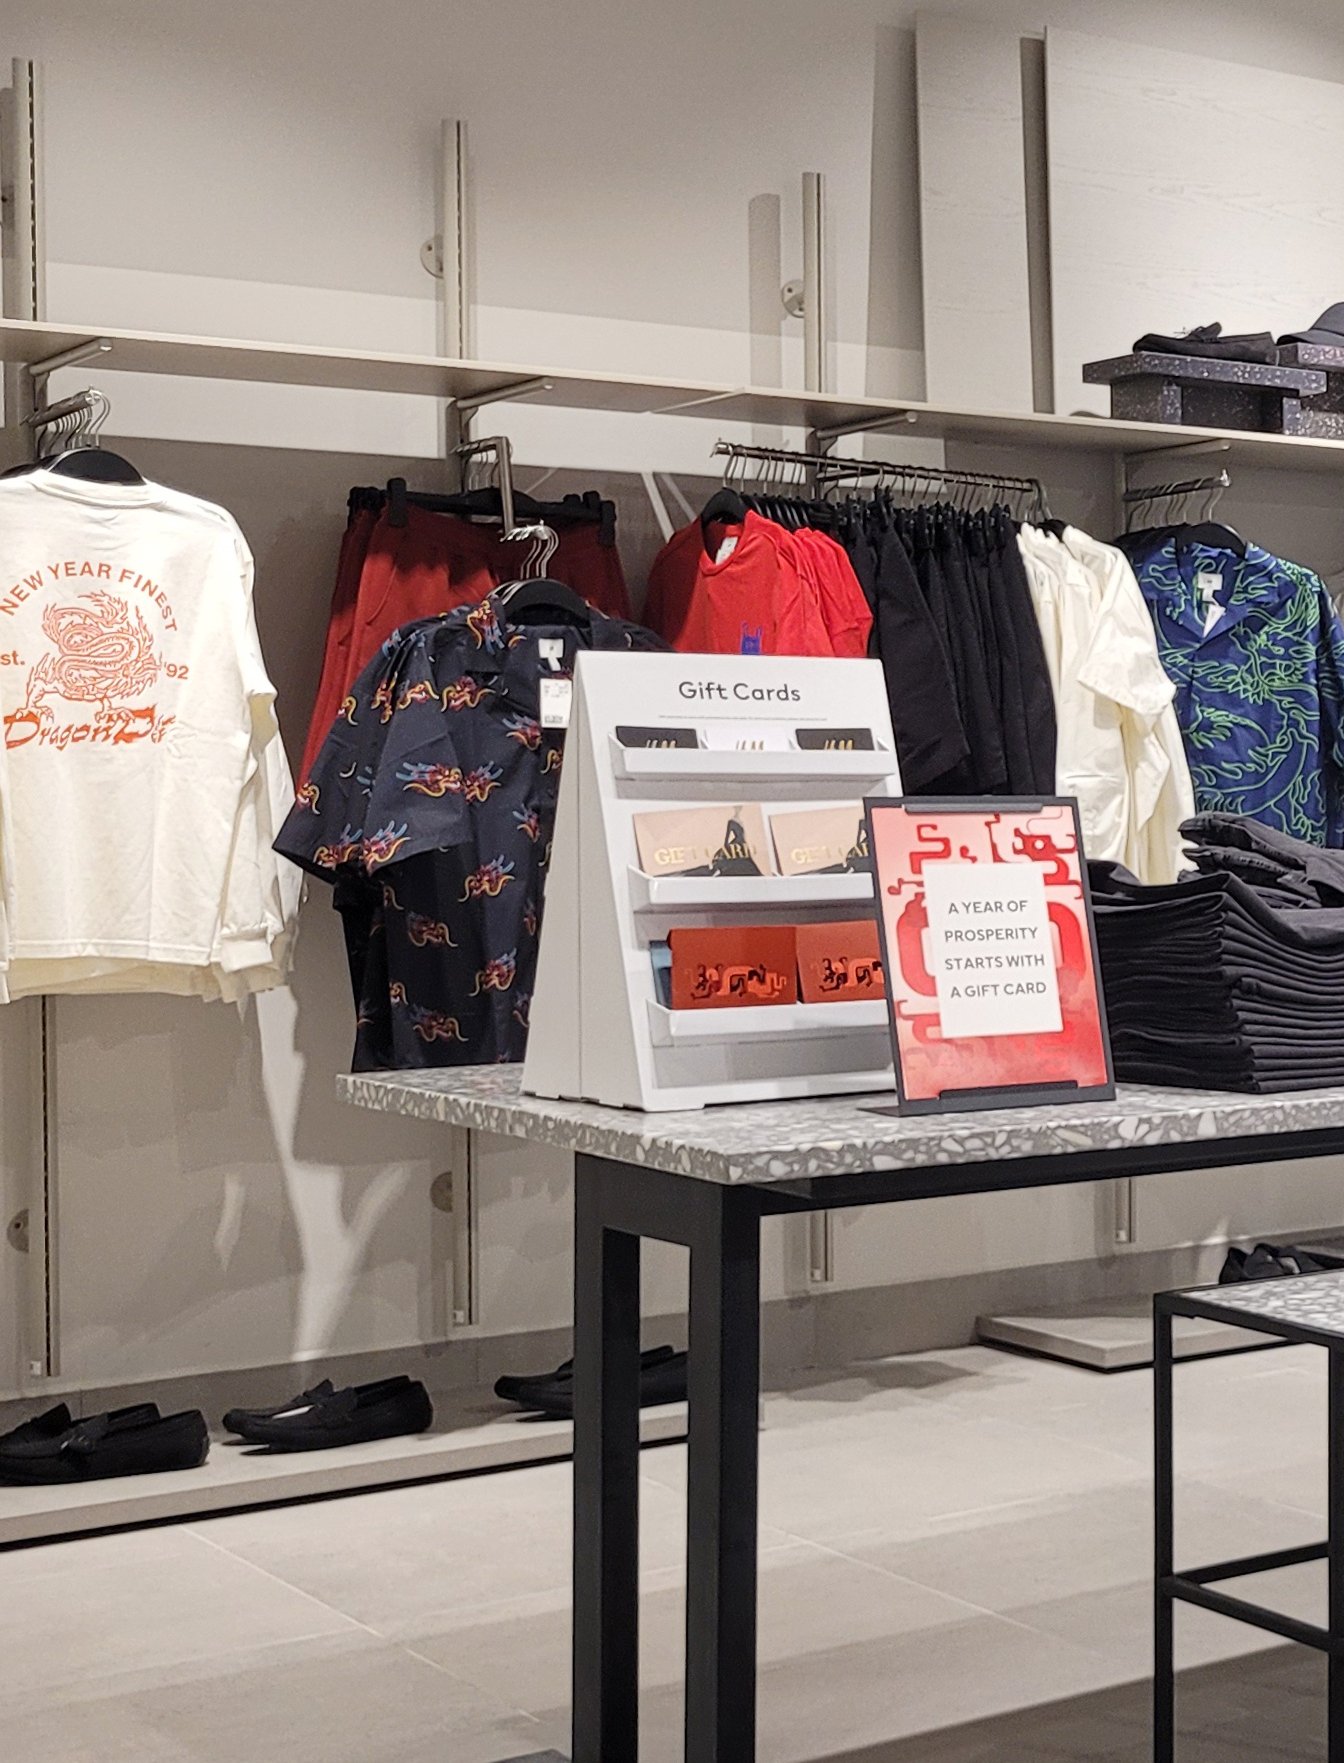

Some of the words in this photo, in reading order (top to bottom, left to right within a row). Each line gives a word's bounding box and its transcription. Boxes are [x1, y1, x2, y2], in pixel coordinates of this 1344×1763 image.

[0, 570, 44, 616] NEW
[47, 561, 112, 580] YEAR
[118, 568, 178, 632] FINEST
[678, 681, 728, 700] Gift
[733, 683, 801, 702] Cards
[948, 902, 960, 914] A
[962, 901, 1005, 914] YEAR
[1007, 900, 1029, 913] OF
[944, 927, 1038, 943] PROSPERITY
[944, 956, 1004, 971] STARTS
[1006, 954, 1045, 968] WITH
[950, 986, 962, 999] A
[965, 984, 1000, 998] GIFT
[1003, 982, 1047, 996] CARD
